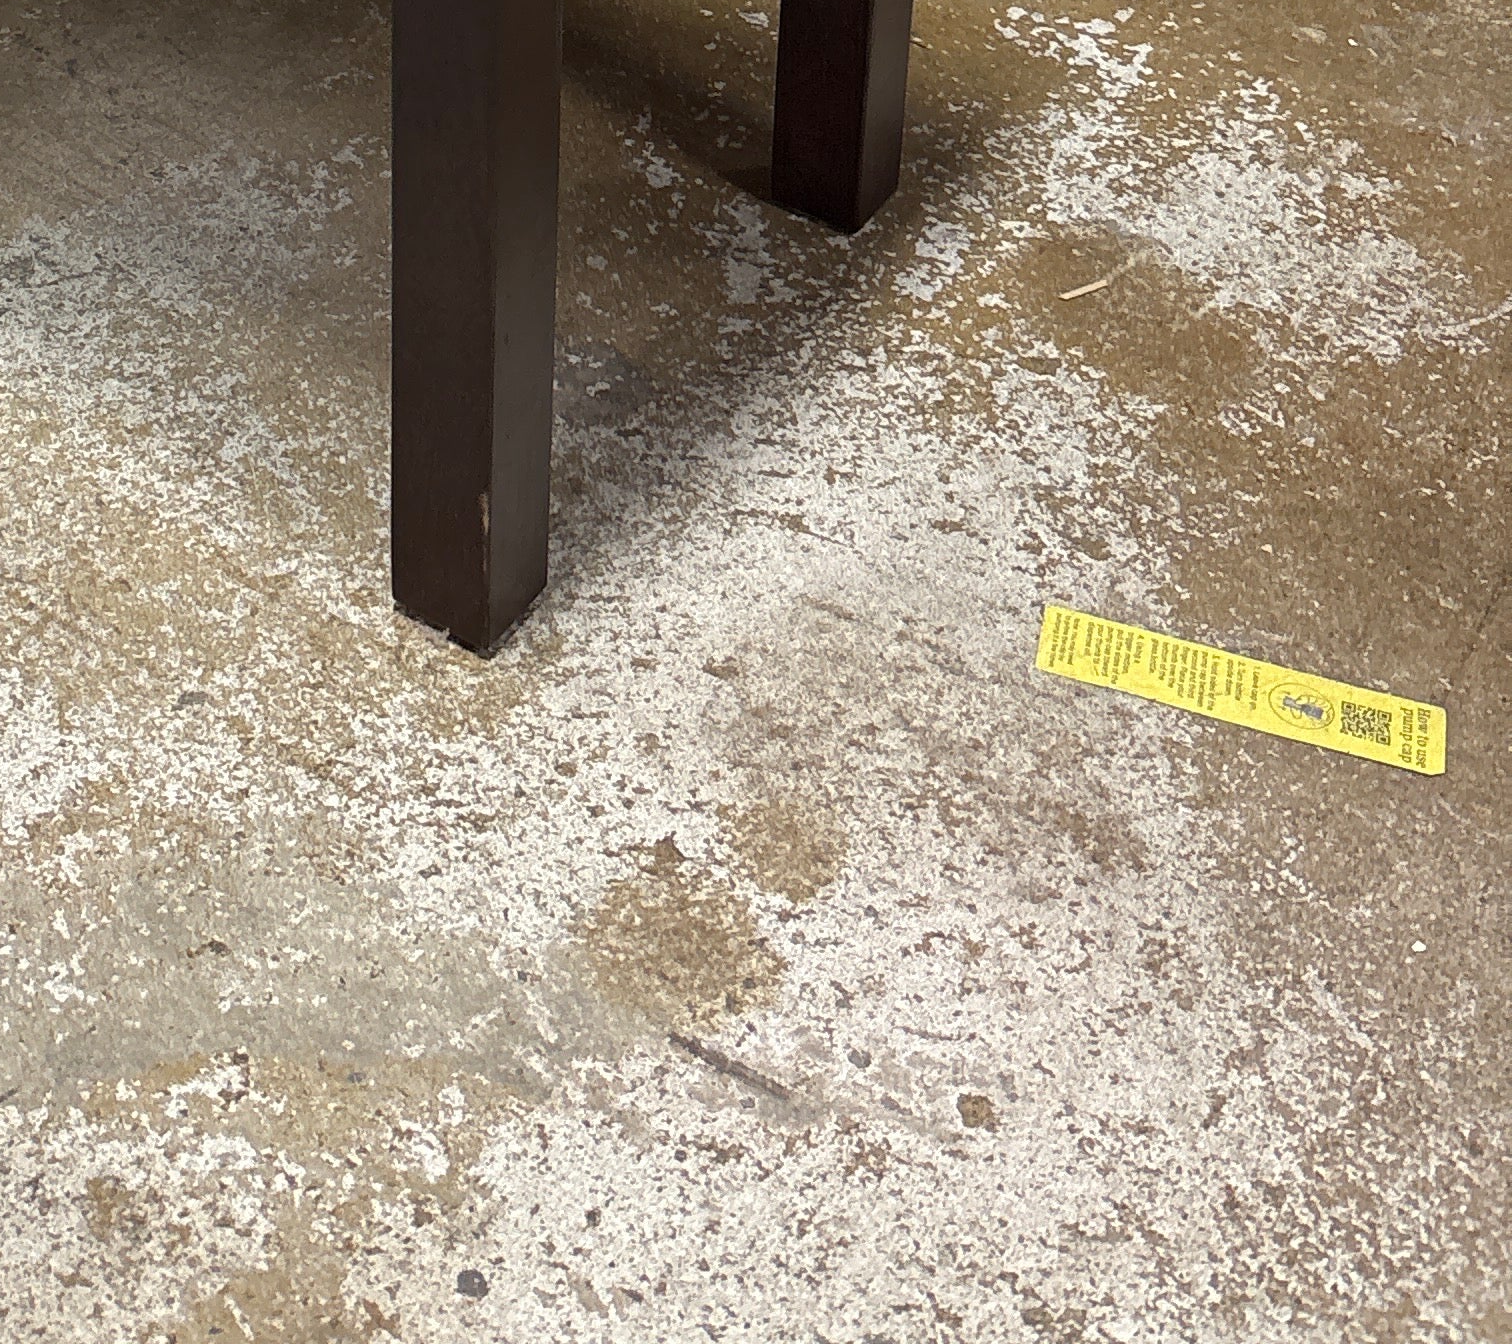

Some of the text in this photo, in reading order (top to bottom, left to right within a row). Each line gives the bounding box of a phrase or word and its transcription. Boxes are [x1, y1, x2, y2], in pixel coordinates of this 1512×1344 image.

[1398, 707, 1413, 763] pump cap
[1416, 708, 1430, 768] How to use
